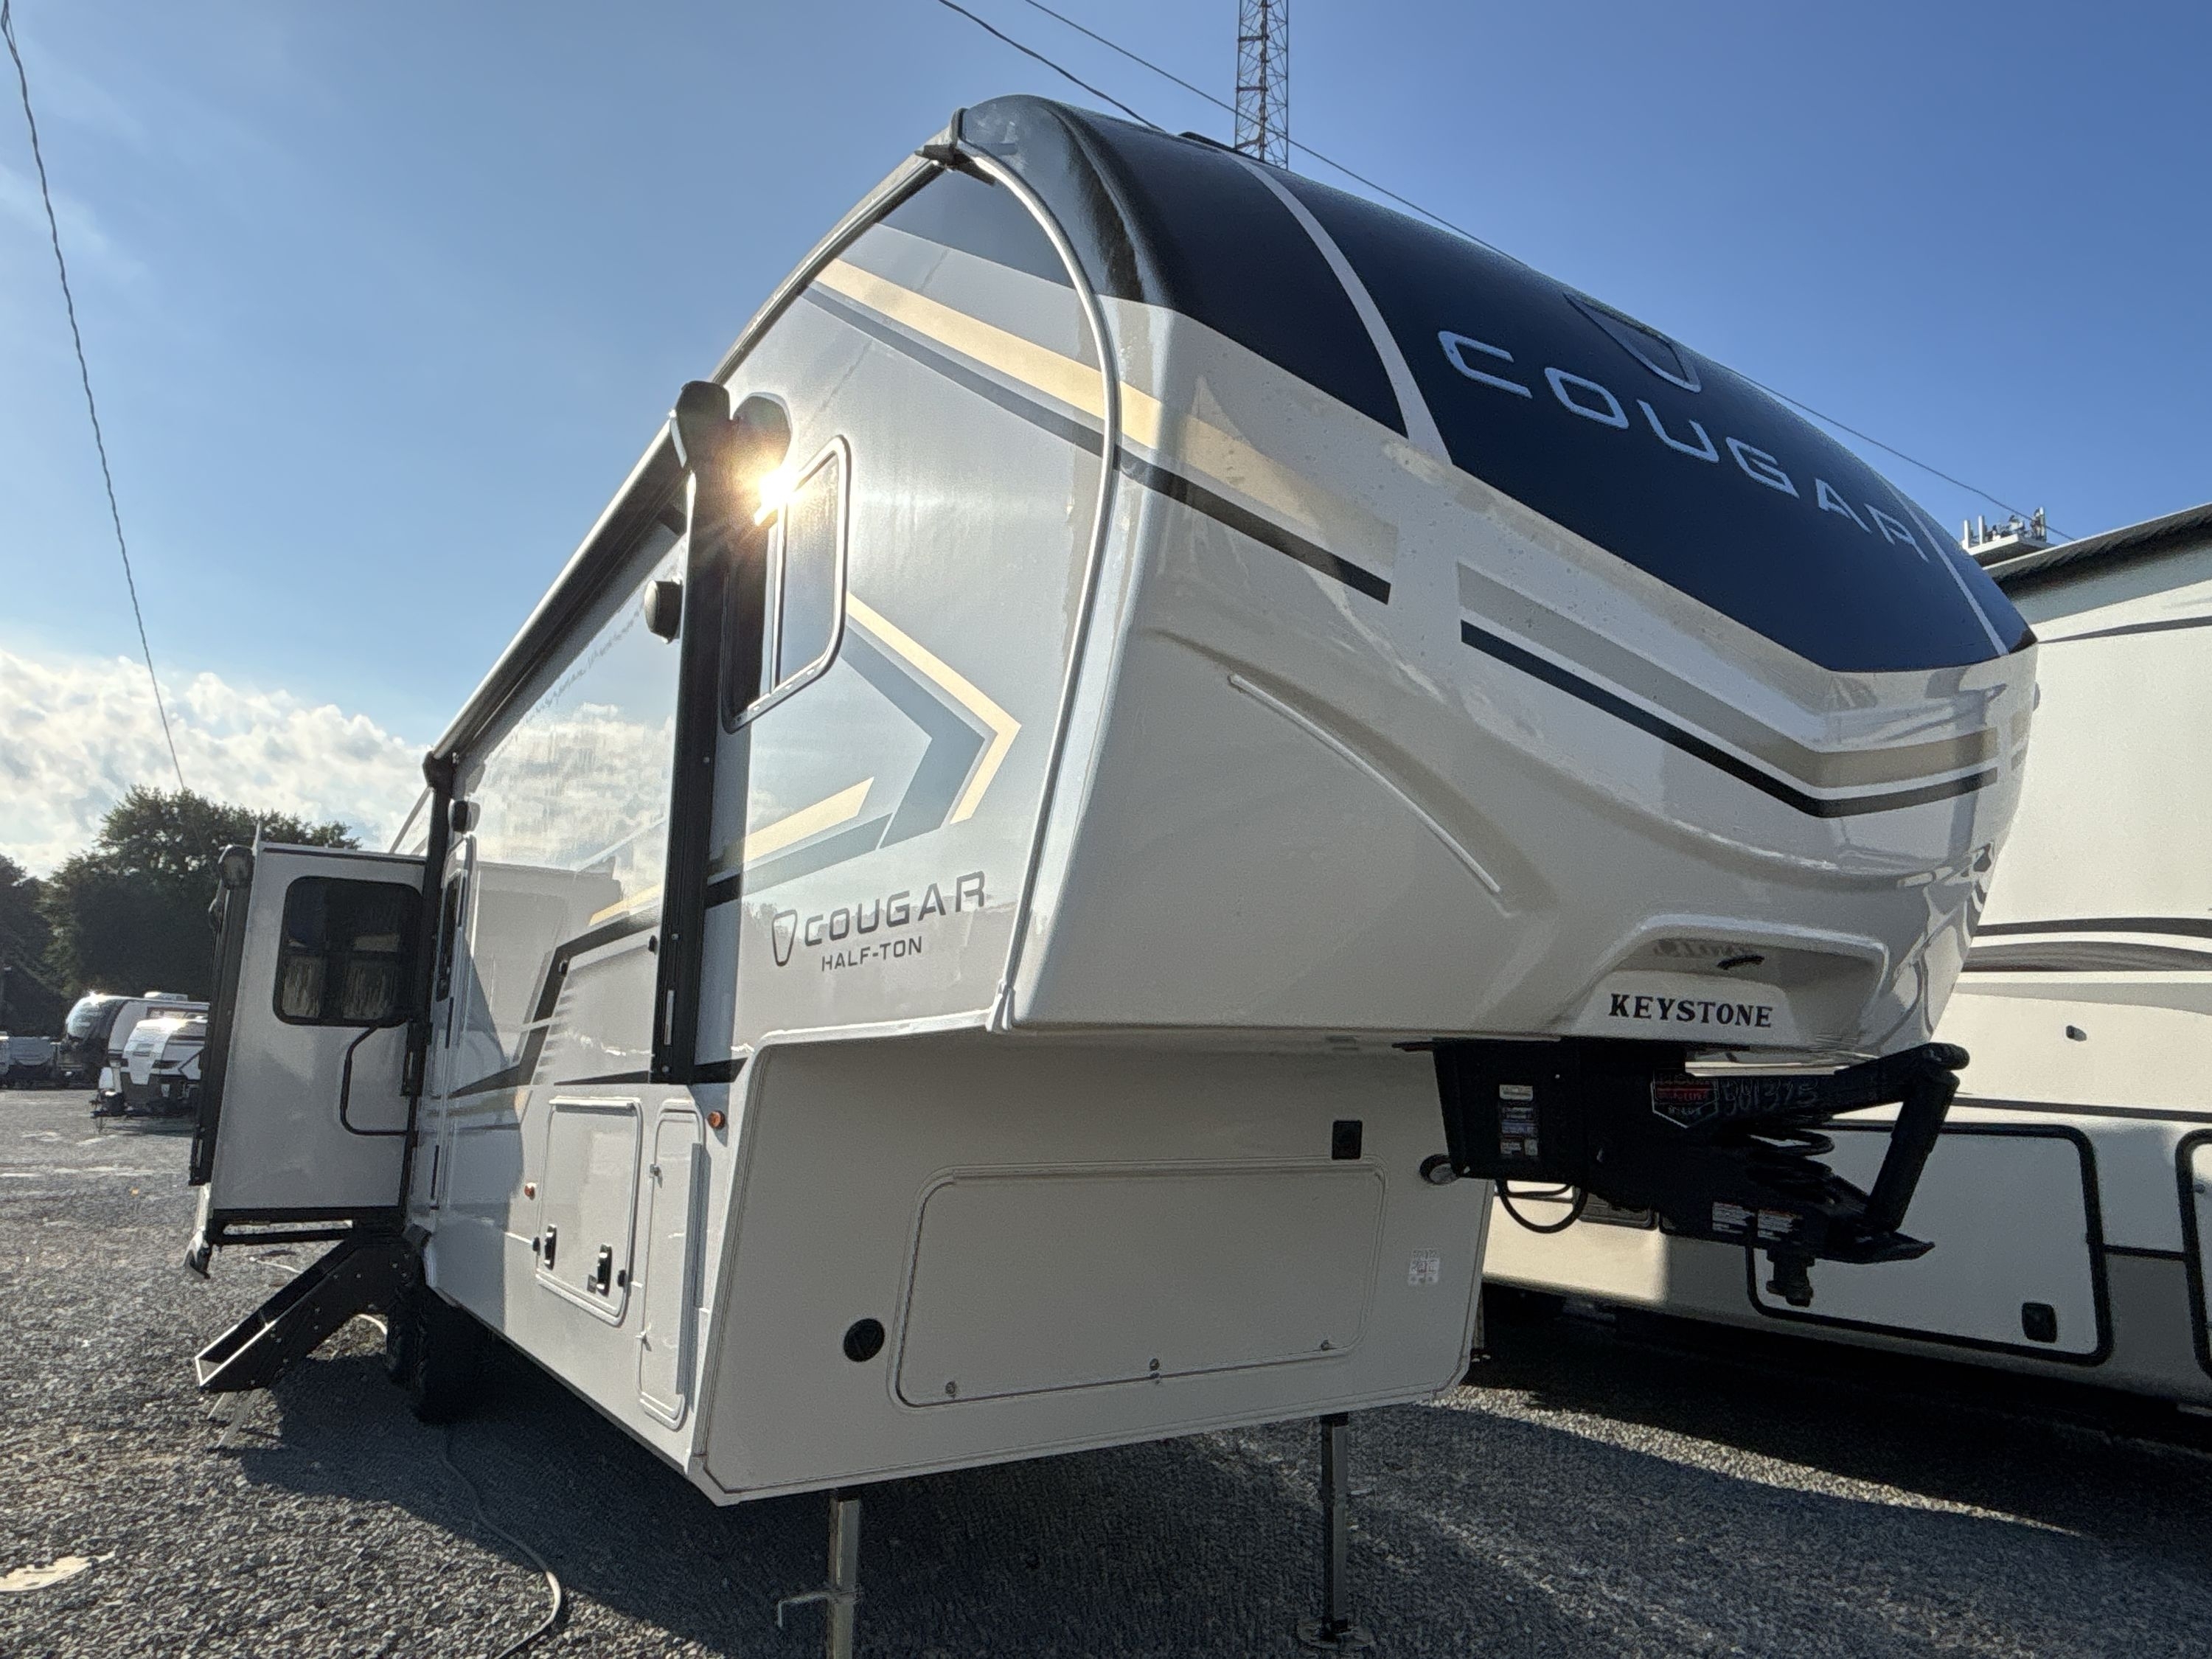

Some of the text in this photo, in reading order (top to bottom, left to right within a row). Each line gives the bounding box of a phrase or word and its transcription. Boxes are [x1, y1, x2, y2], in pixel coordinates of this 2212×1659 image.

[1437, 330, 1929, 563] COUGAR
[804, 870, 985, 947] COUGAR
[821, 936, 922, 972] HALF-TON
[1608, 993, 1773, 1028] KEYSTONE
